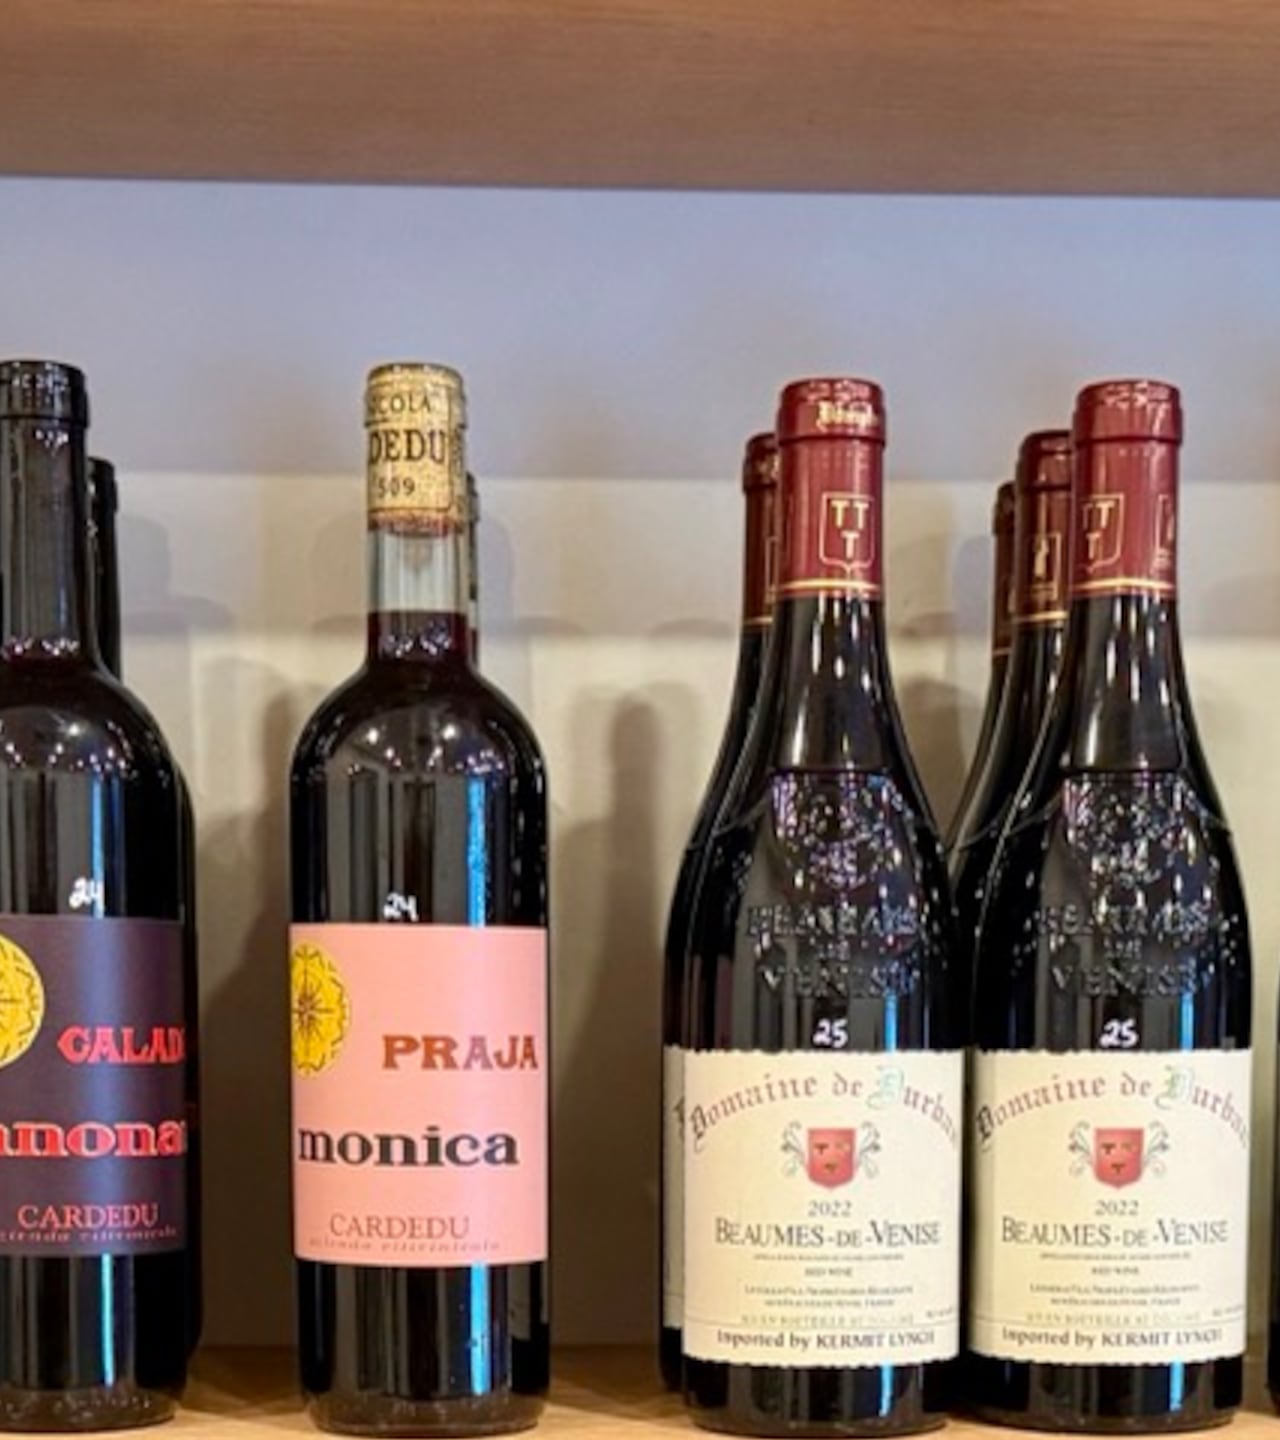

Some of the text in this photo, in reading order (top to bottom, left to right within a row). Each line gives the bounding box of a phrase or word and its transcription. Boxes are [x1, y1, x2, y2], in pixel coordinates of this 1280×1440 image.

[812, 1018, 848, 1048] 25
[1100, 1018, 1138, 1048] 25
[382, 1034, 539, 1070] PRAJA
[833, 1072, 864, 1099] de
[1120, 1072, 1152, 1099] de
[297, 1125, 520, 1167] monica
[18, 1204, 158, 1229] CARDEDU
[808, 1200, 852, 1218] 2022
[1095, 1200, 1140, 1217] 2022
[330, 1214, 470, 1240] CARDEDU
[790, 1331, 810, 1351] by
[816, 1332, 884, 1349] KERMIT
[1074, 1329, 1095, 1349] by
[1101, 1331, 1170, 1348] KERMIT
